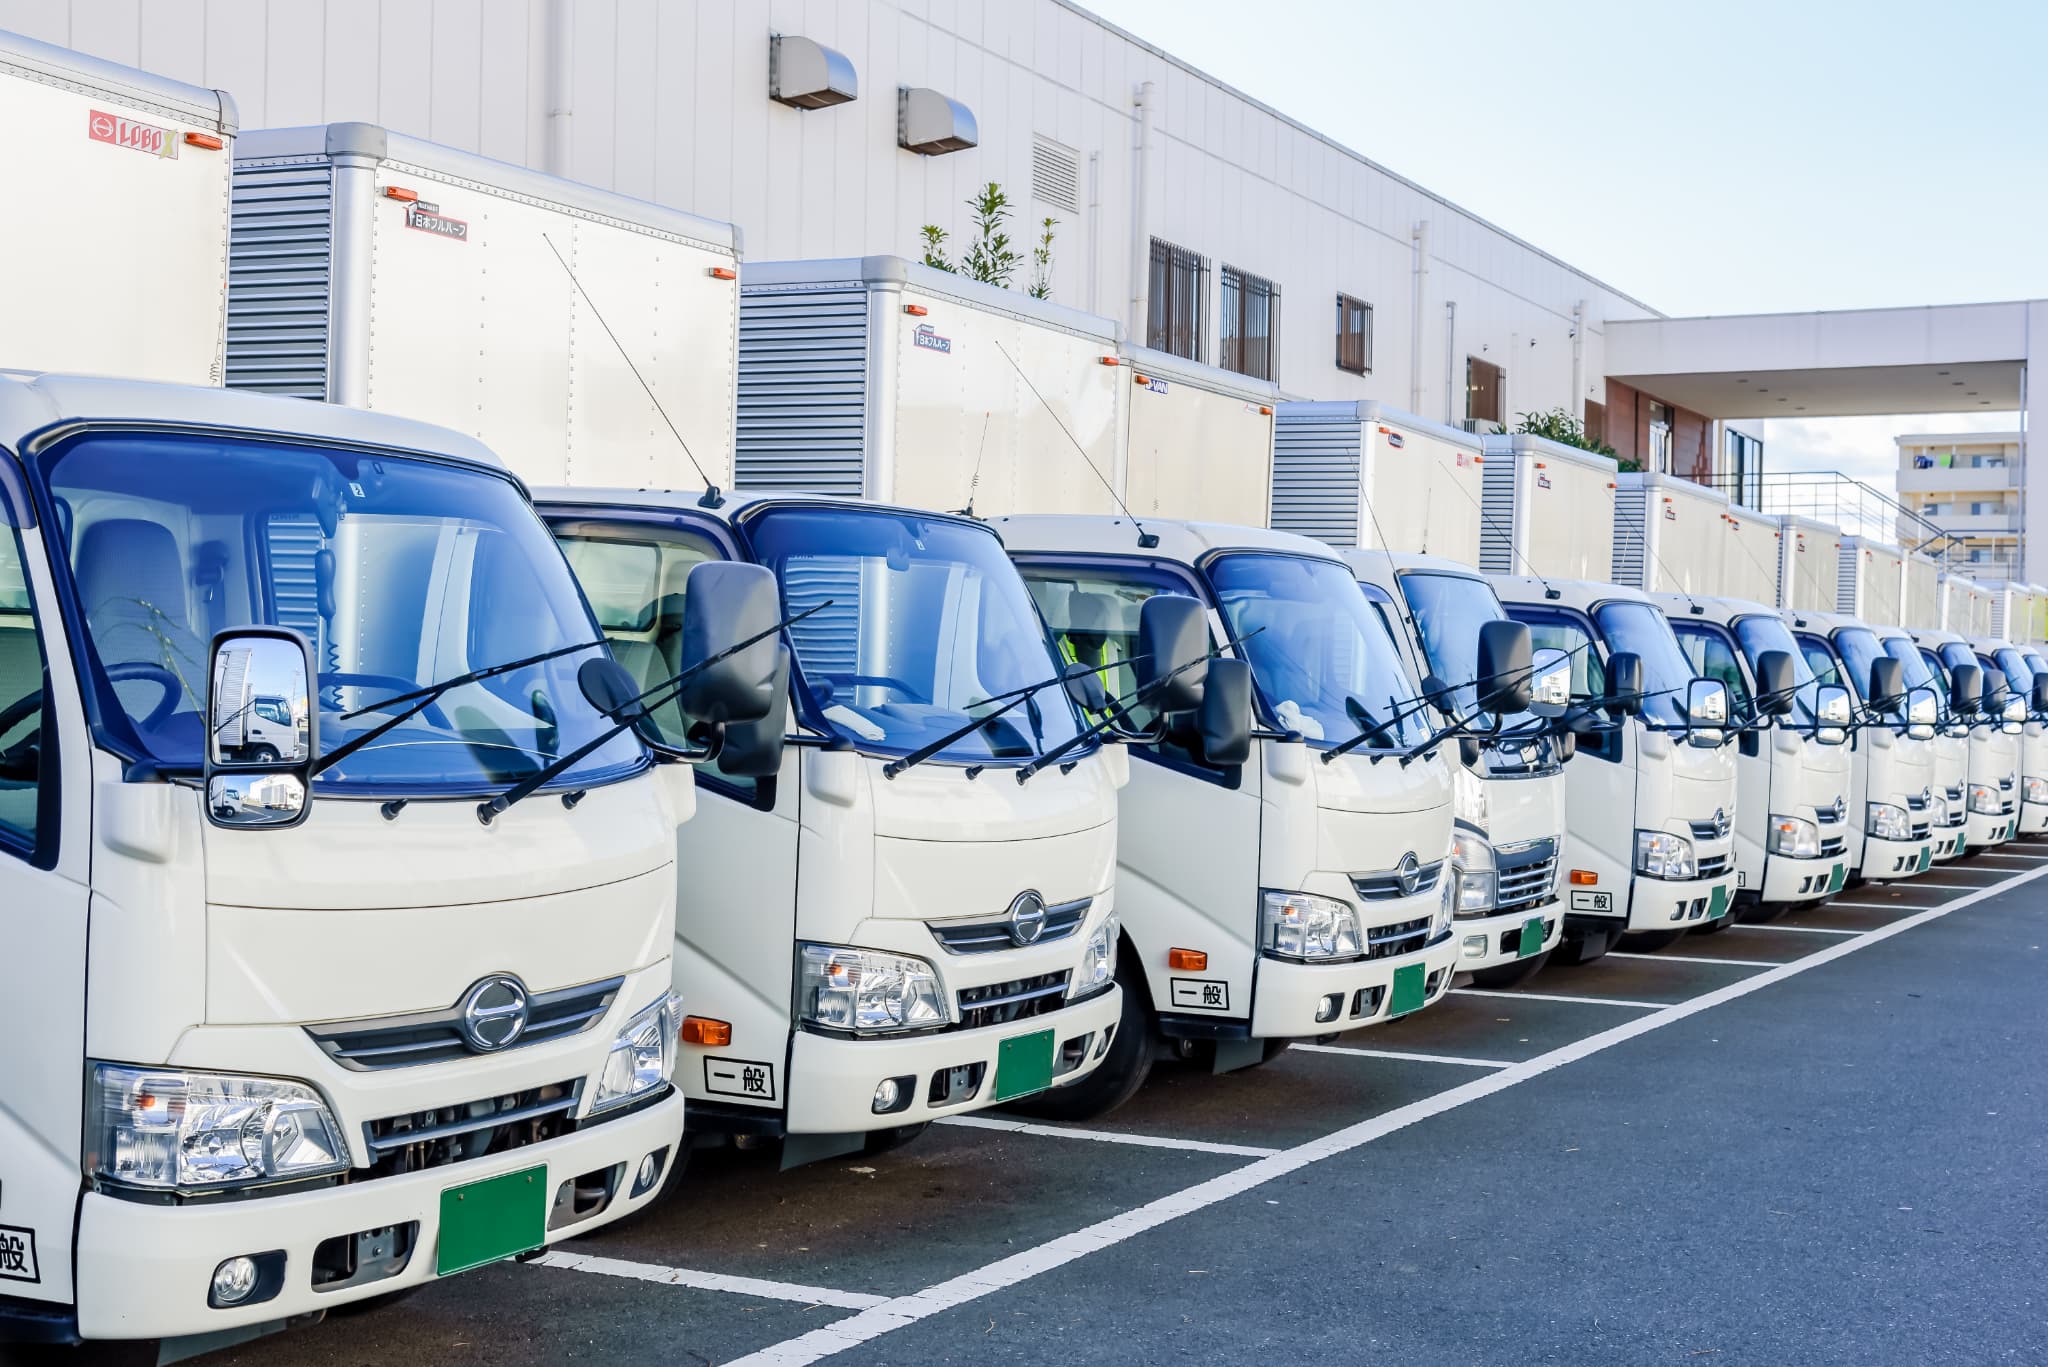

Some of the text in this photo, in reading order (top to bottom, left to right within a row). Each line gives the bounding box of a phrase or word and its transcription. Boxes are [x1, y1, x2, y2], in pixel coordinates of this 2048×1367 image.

[120, 122, 177, 159] LOBOX
[415, 214, 466, 236] 日本フルハーフ
[1576, 894, 1608, 909] 一般
[1178, 984, 1222, 1005] 一般
[713, 1066, 767, 1094] 一般
